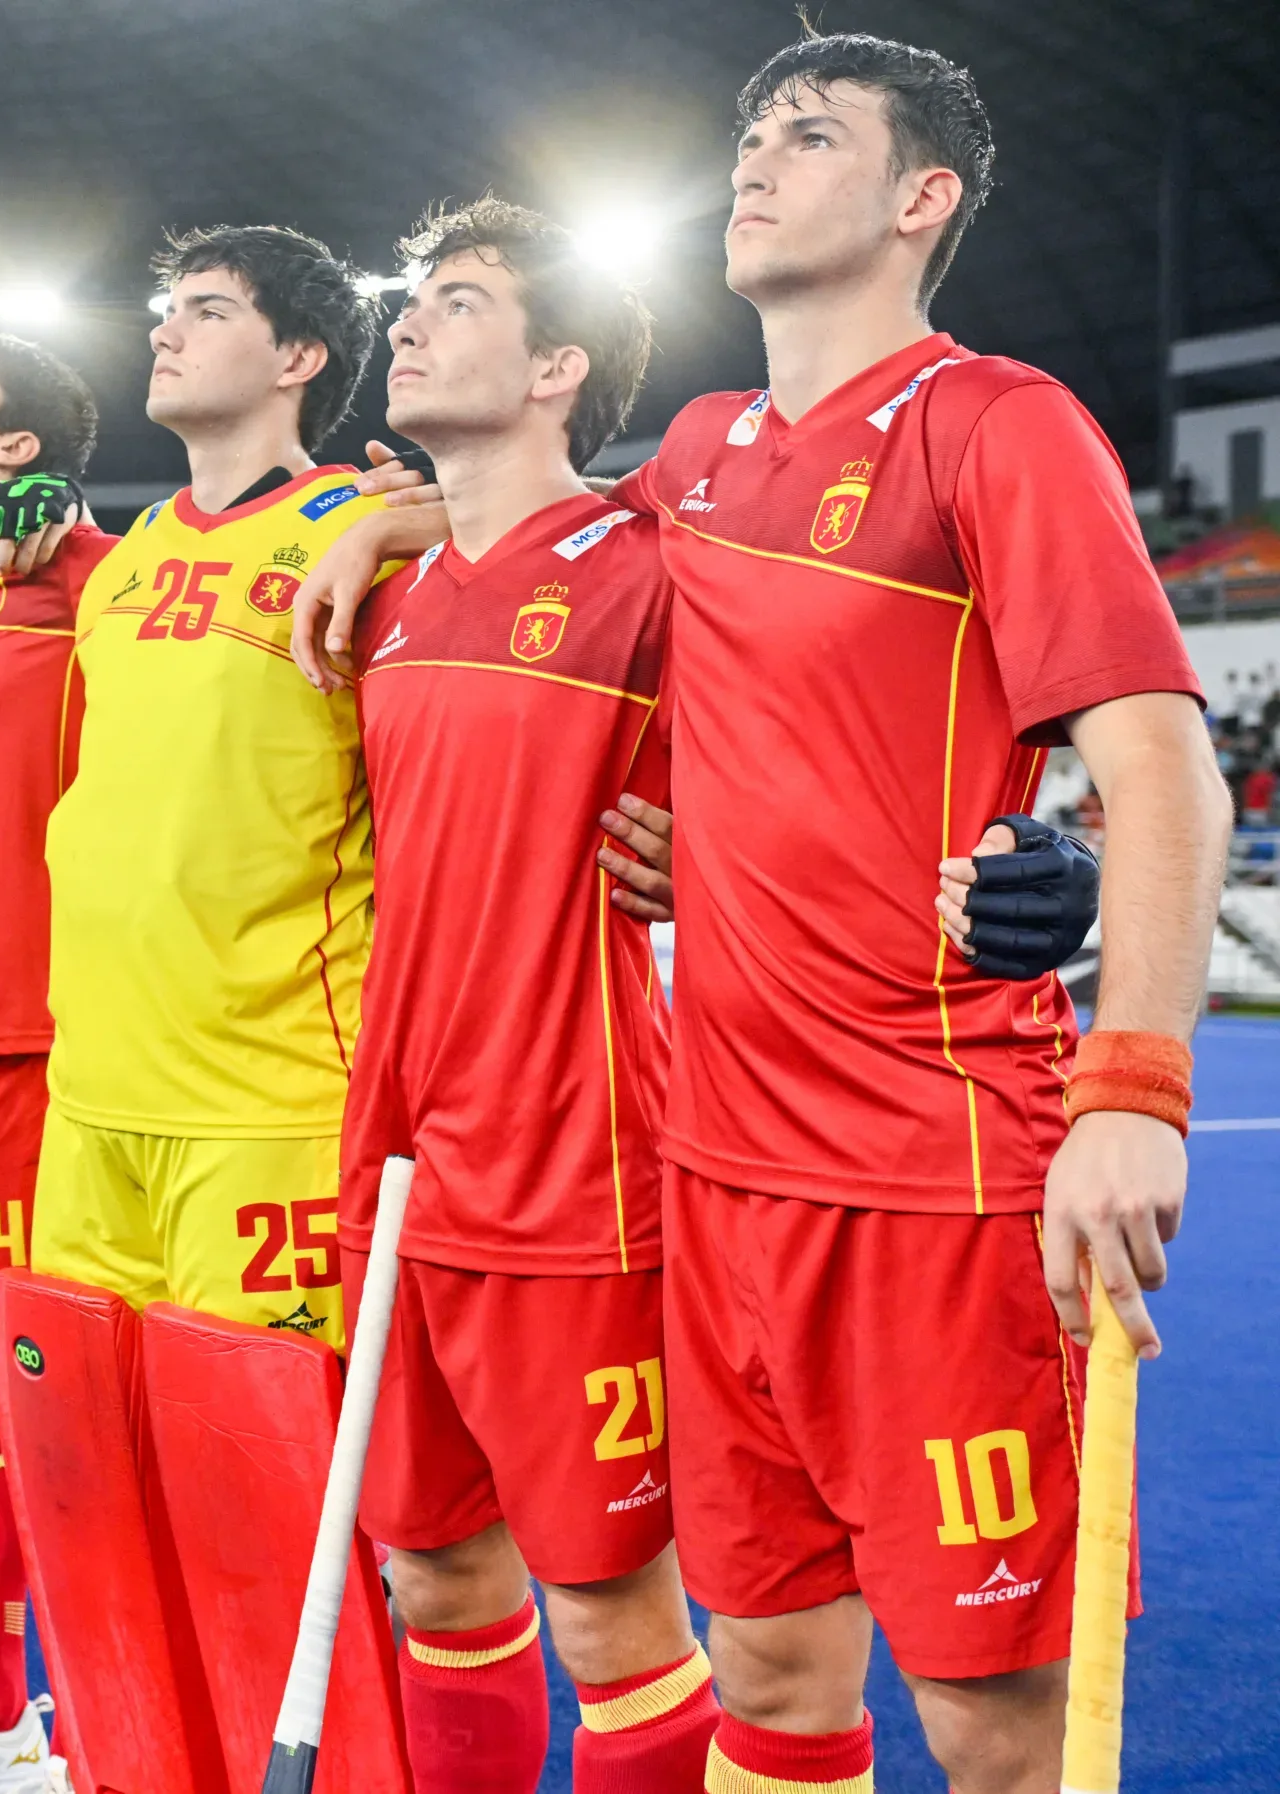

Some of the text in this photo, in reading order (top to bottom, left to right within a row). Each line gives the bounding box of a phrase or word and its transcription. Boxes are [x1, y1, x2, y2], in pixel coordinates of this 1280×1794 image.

[315, 490, 355, 510] MGS
[570, 524, 608, 548] MGS
[135, 558, 234, 642] 25
[236, 1197, 342, 1293] 25
[15, 1343, 40, 1369] OBO
[584, 1356, 665, 1462] 21
[606, 1482, 668, 1514] MERCURY
[924, 1429, 1039, 1546] 10
[954, 1578, 1043, 1606] MERCURY
